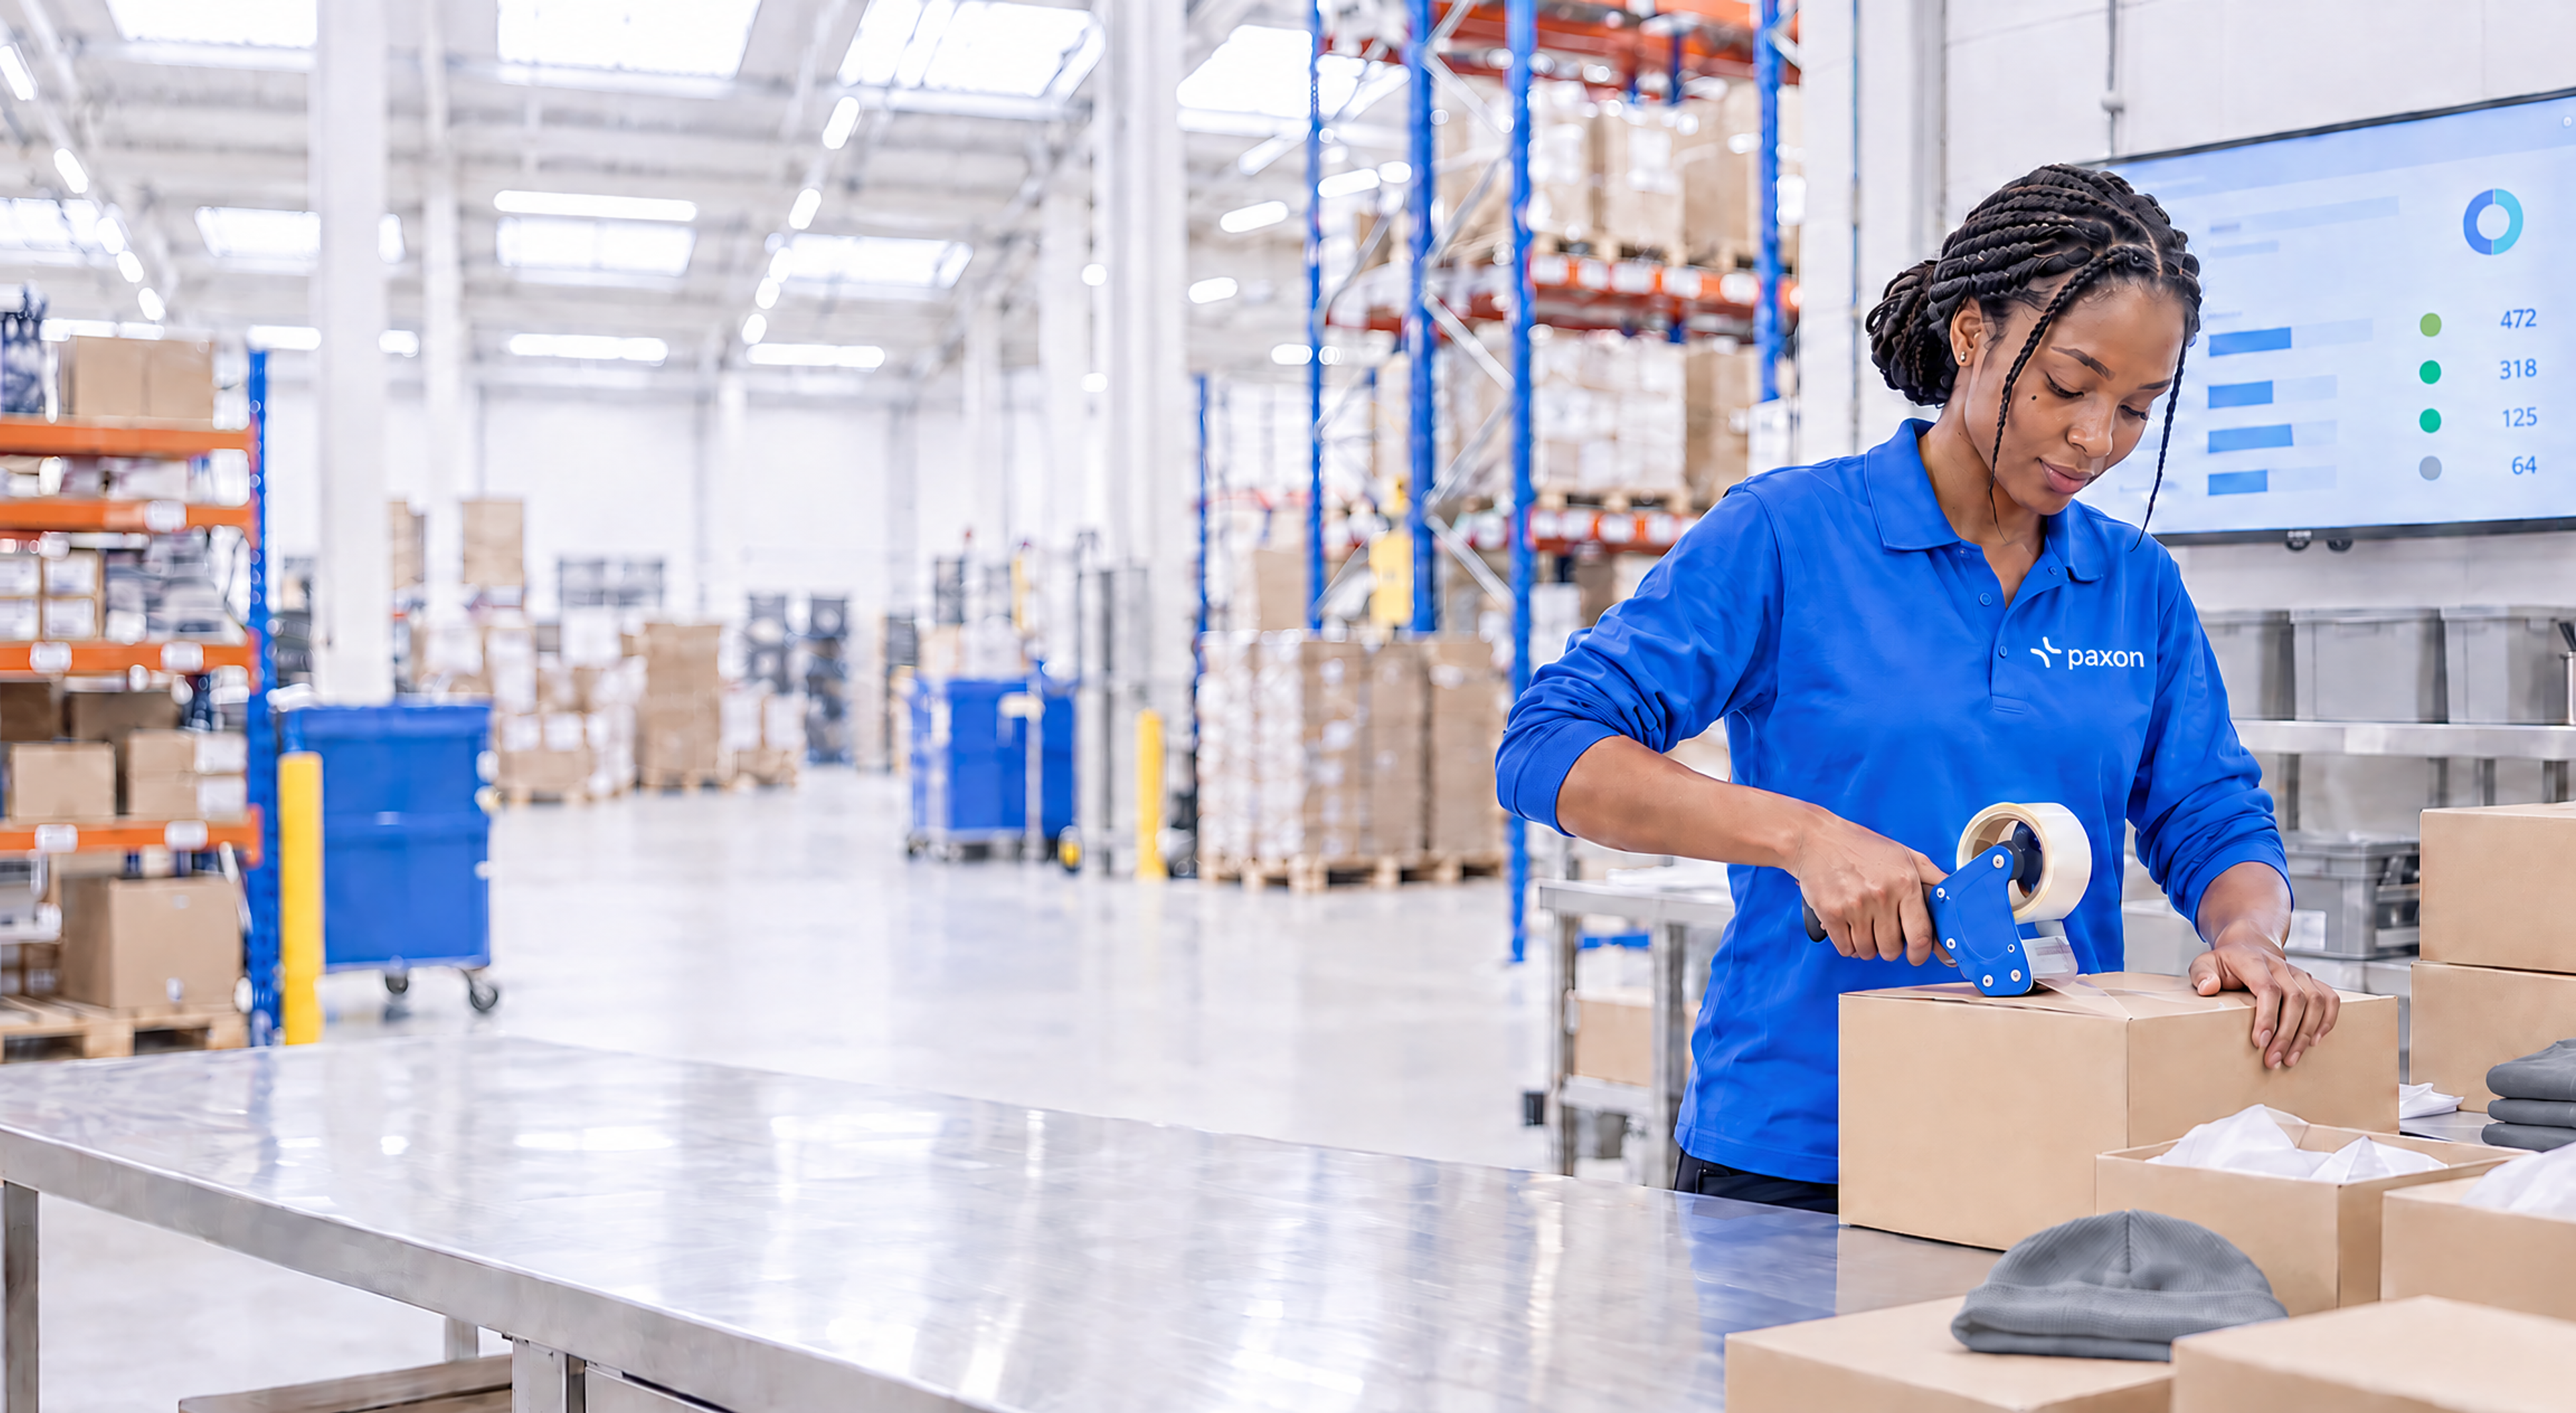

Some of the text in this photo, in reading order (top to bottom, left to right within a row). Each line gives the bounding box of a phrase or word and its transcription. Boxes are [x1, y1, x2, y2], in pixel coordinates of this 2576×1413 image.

[2500, 308, 2537, 329] 472
[2500, 358, 2537, 380] 318
[2502, 406, 2538, 428] 125
[2512, 455, 2537, 475] 64
[2068, 648, 2145, 671] paxon
